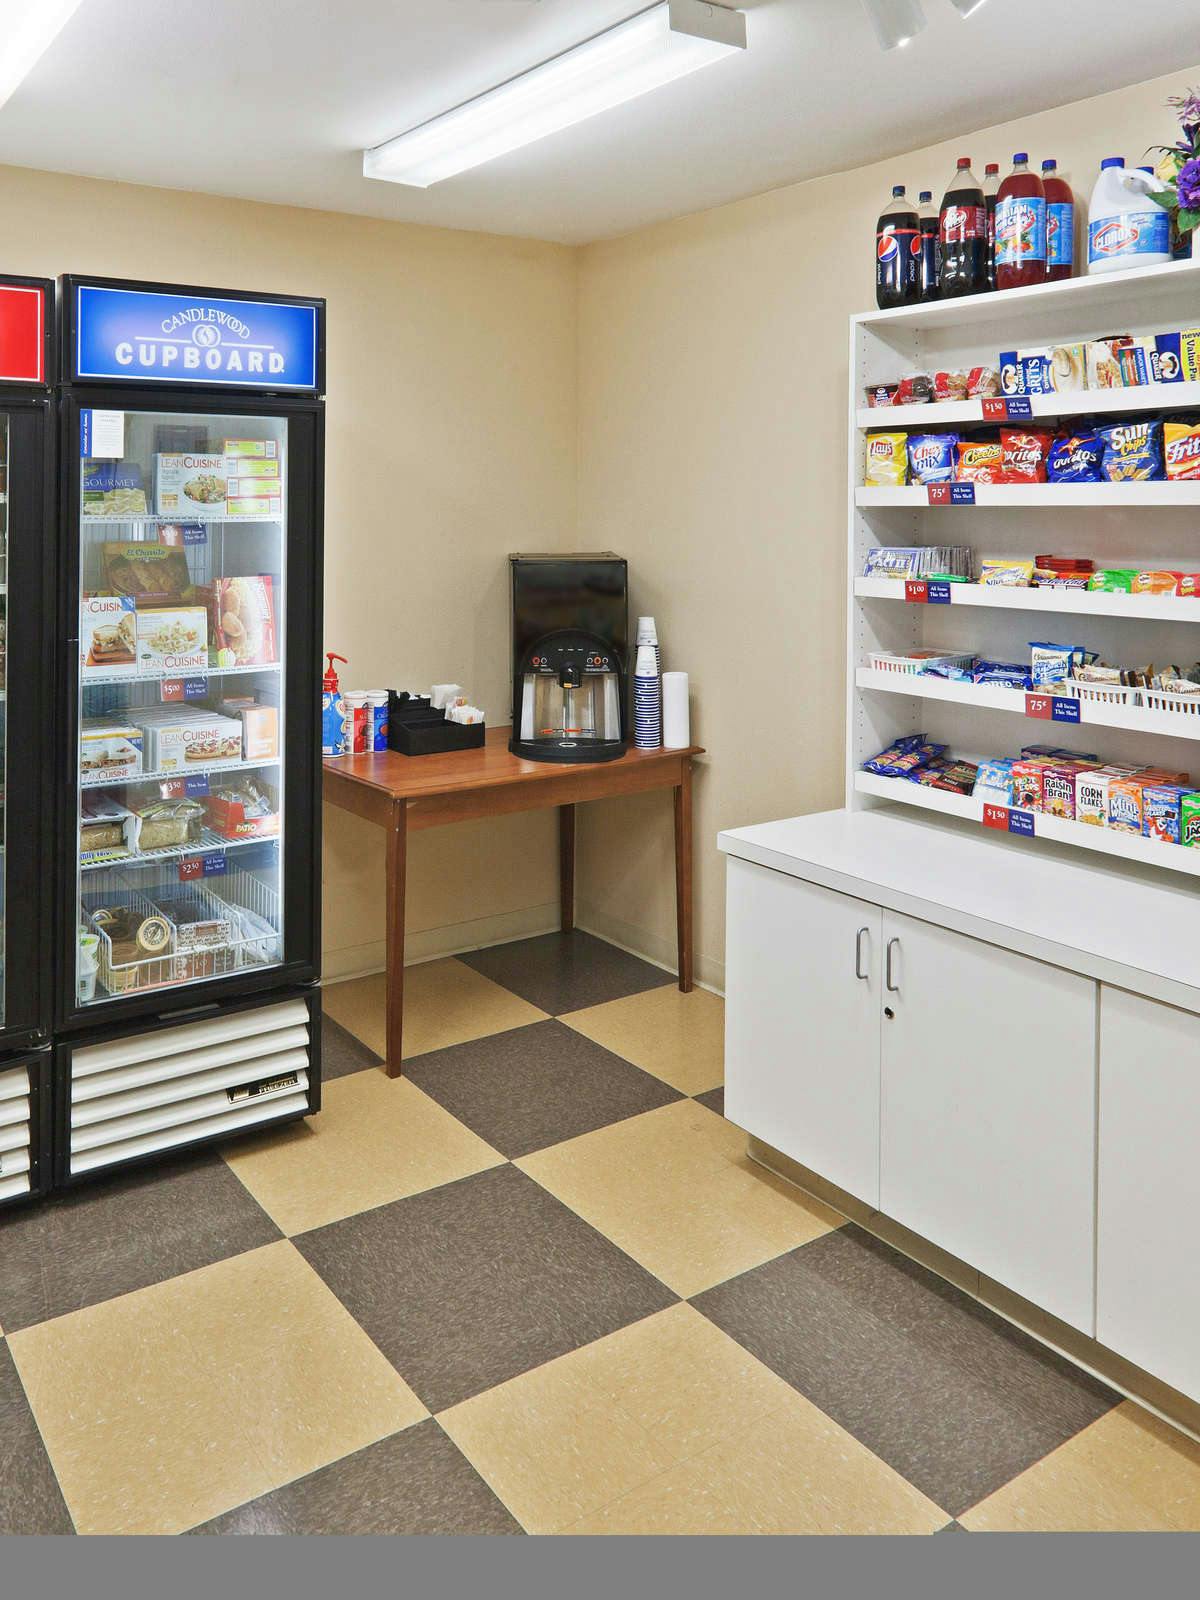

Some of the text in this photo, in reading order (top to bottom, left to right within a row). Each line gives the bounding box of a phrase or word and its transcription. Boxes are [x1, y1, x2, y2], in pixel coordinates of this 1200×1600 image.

[161, 308, 250, 339] CANDLEWOOD
[115, 342, 285, 373] CUPBOARD
[1186, 340, 1196, 367] Value
[1016, 363, 1025, 394] QUAKER
[1028, 358, 1043, 395] GRITS
[1111, 423, 1149, 451] Sun
[1120, 436, 1146, 455] Chips
[1004, 448, 1043, 464] oritos
[1167, 434, 1200, 464] Frit
[83, 478, 135, 488] GOURMET
[1045, 779, 1072, 794] Raisin
[1048, 788, 1070, 801] Bran
[1080, 786, 1103, 799] CORN
[1080, 796, 1104, 808] FLAKES
[236, 823, 257, 833] PATIO
[1021, 822, 1033, 830] Shelf
